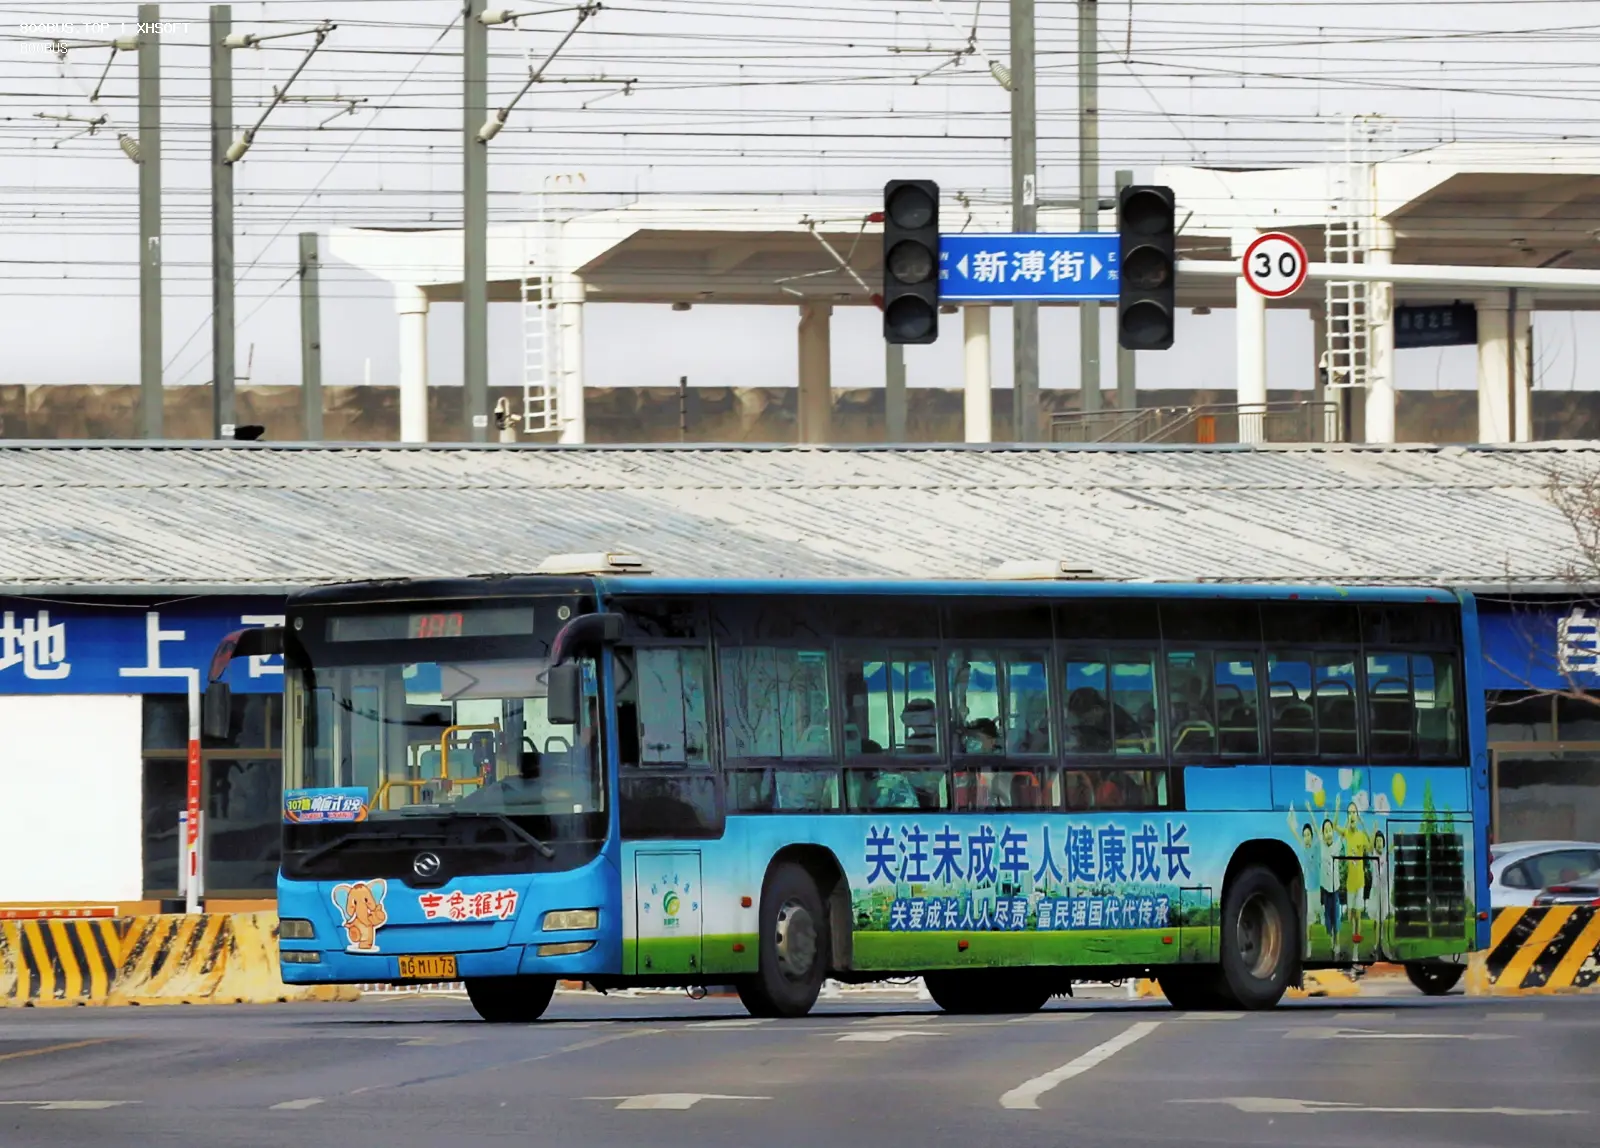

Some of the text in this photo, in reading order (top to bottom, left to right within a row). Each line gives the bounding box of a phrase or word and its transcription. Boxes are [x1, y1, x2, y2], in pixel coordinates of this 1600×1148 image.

[972, 250, 1084, 283] 新溥街
[1108, 252, 1116, 262] E
[1254, 252, 1296, 278] 30
[865, 822, 1192, 884] 关注未成年人健康成长
[891, 898, 1169, 929] 关爱成长人人尽责 富民强国代代传承
